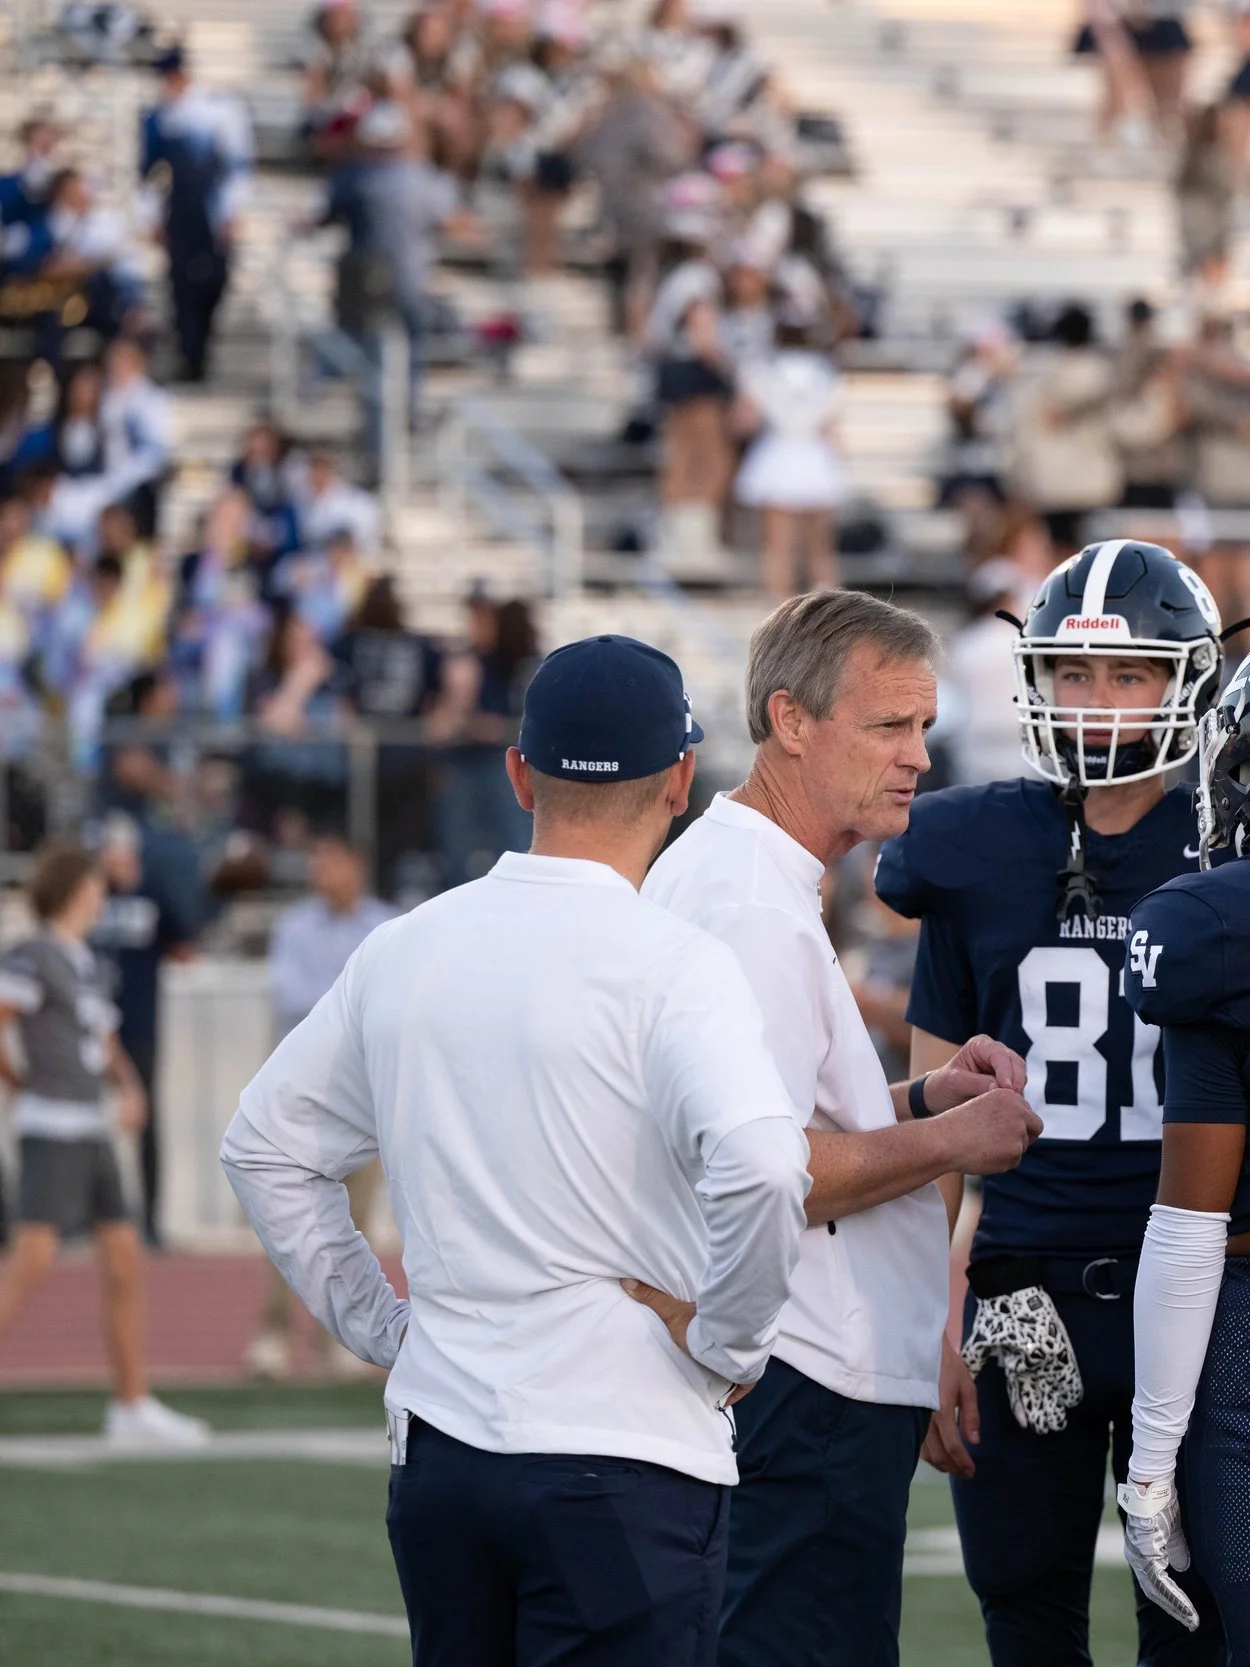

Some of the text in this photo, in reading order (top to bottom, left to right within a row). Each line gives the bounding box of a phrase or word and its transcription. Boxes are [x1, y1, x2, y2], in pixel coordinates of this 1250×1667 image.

[1066, 617, 1120, 630] Riddell
[561, 758, 619, 772] RANGERS
[1059, 914, 1132, 940] RANGER
[1130, 930, 1163, 987] SV
